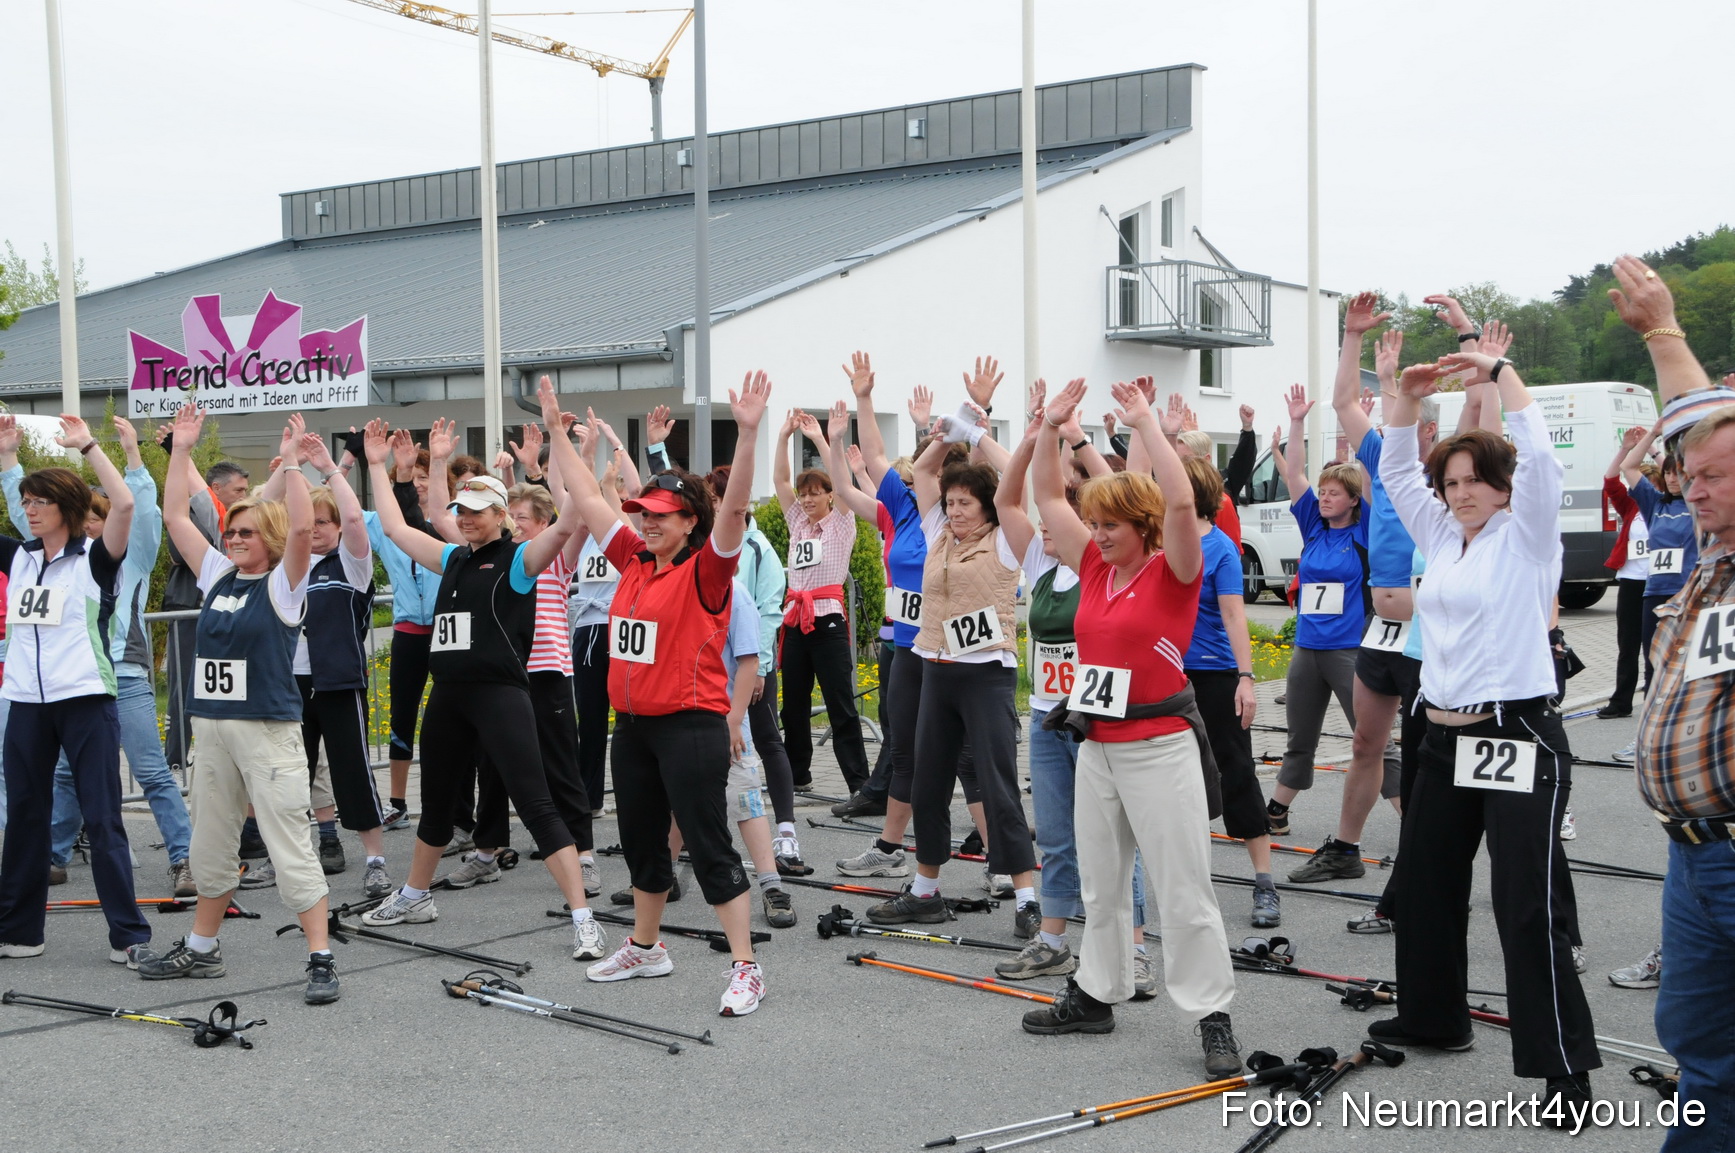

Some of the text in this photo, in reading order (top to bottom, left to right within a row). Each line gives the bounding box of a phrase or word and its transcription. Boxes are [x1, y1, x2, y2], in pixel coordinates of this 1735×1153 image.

[141, 344, 353, 392] Trend Creativ
[135, 399, 155, 414] Der
[240, 393, 258, 407] mit
[263, 391, 297, 406] Ideen
[302, 388, 323, 404] und
[328, 385, 359, 402] Pfiff
[586, 555, 607, 578] 28
[796, 541, 813, 564] 29
[1654, 550, 1673, 570] 44
[18, 588, 50, 618] 94
[901, 592, 922, 620] 18
[1315, 585, 1327, 610] 7
[439, 615, 457, 645] 91
[618, 620, 646, 656] 90
[951, 611, 993, 648] 124
[1378, 620, 1402, 646] 77
[205, 661, 233, 694] 95
[1043, 661, 1075, 694] 26
[1080, 668, 1114, 708] 24
[1473, 740, 1517, 783] 22
